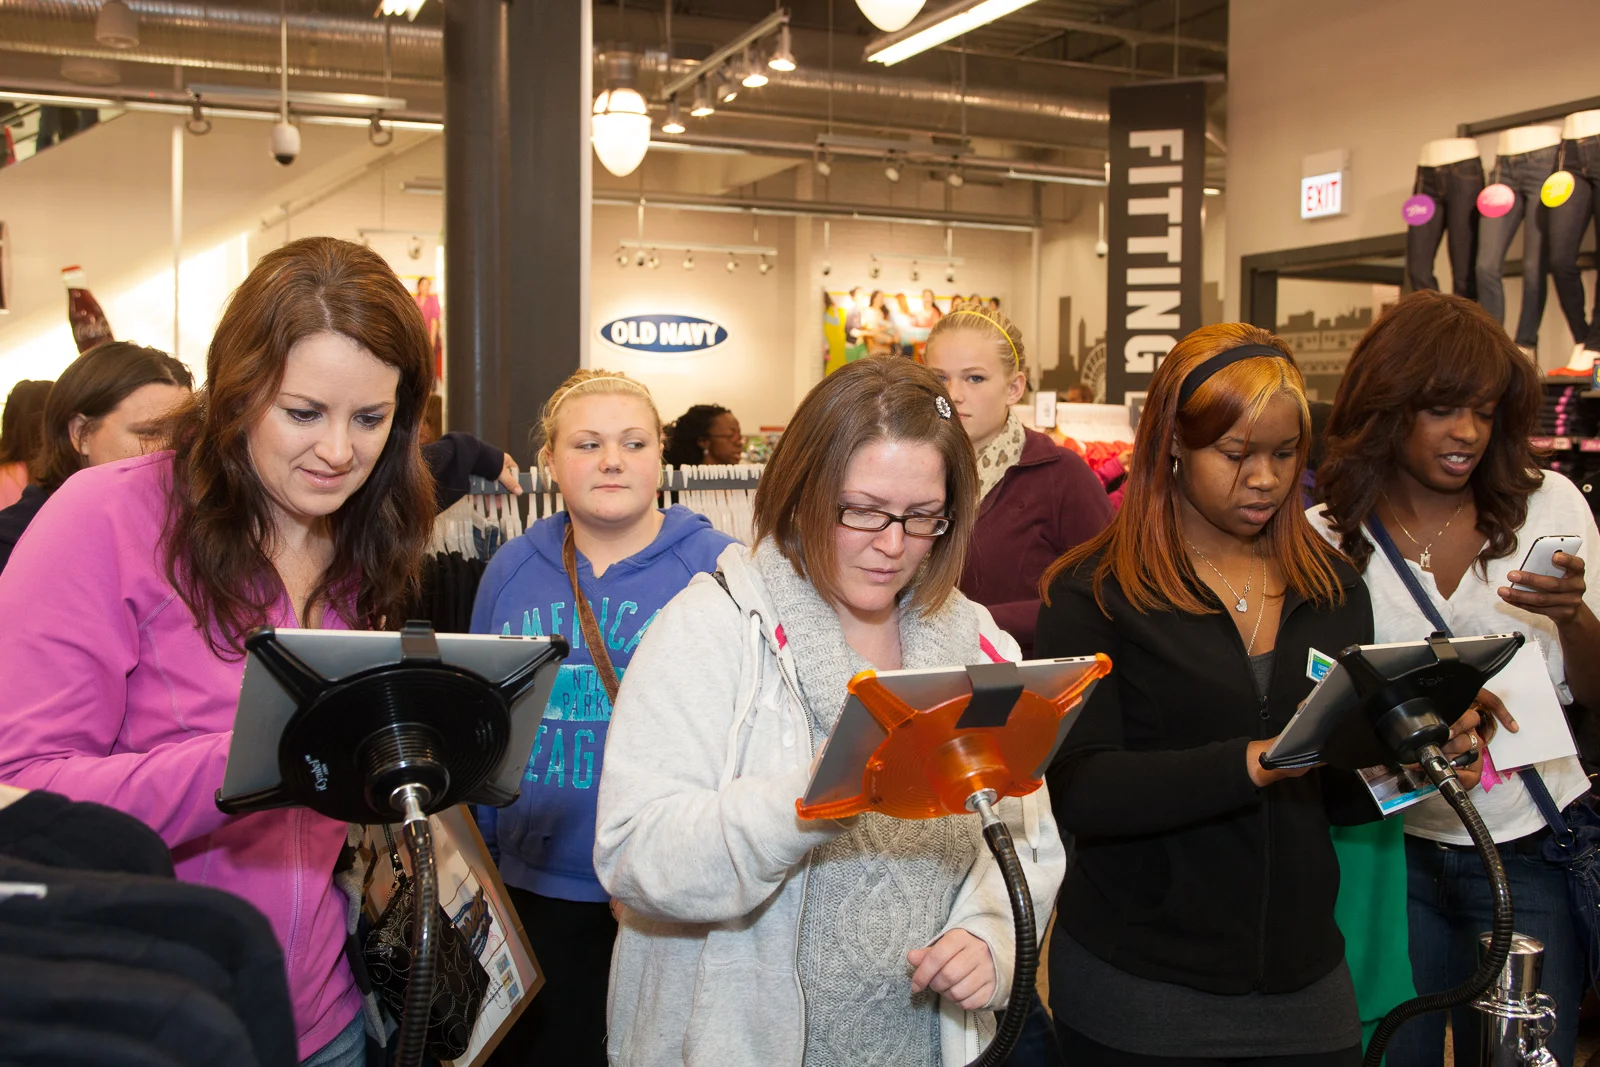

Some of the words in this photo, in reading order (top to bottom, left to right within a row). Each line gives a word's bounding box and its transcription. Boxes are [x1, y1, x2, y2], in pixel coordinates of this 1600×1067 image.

[1307, 181, 1338, 211] EXIT
[1124, 129, 1183, 373] FITTING
[611, 320, 658, 345] OLD
[659, 321, 720, 346] NAVY
